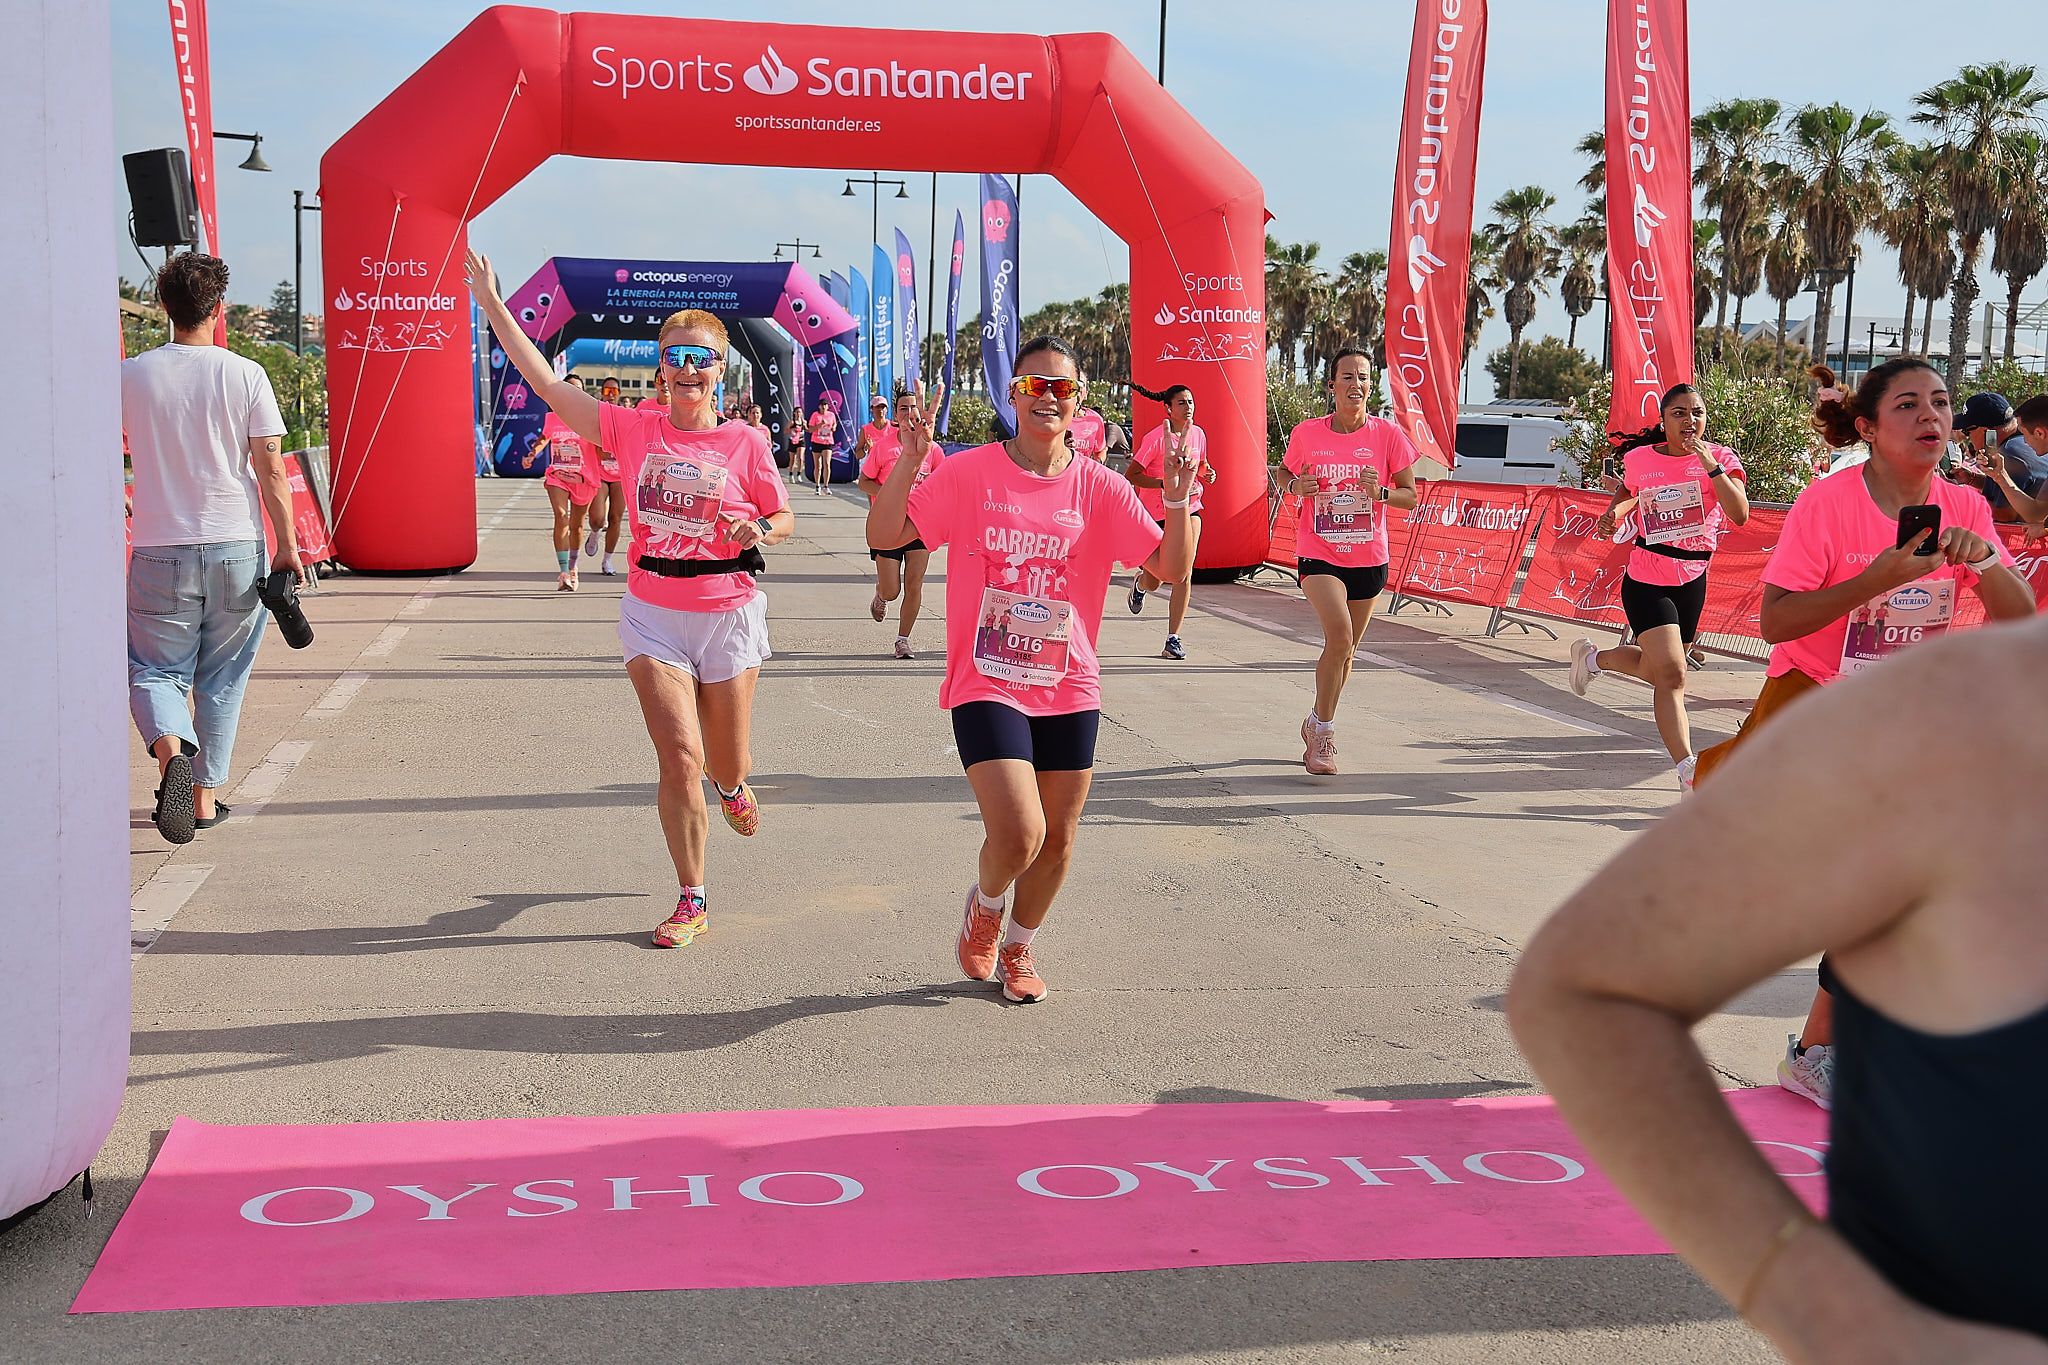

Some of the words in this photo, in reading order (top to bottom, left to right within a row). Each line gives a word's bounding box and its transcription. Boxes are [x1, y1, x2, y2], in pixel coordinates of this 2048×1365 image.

[592, 46, 734, 99] Sports
[807, 57, 1033, 101] Santander
[735, 115, 881, 132] sportssantander.es
[361, 256, 428, 281] Sports
[633, 270, 687, 285] octopus
[688, 272, 733, 287] energy
[1184, 272, 1243, 295] Sports
[356, 292, 457, 311] Santander
[607, 288, 620, 297] LA
[622, 287, 666, 299] ENERGÍA
[668, 290, 695, 299] PARA
[697, 291, 738, 300] CORRER
[631, 300, 688, 309] VELOCIDAD
[720, 302, 740, 310] LUZ
[1179, 305, 1262, 323] Santander
[603, 339, 655, 362] Marlene
[663, 490, 694, 507] 016
[984, 500, 1022, 515] OYSHO
[1457, 500, 1530, 531] Santander
[1660, 509, 1684, 521] 016
[1333, 514, 1354, 523] 016
[1553, 505, 1605, 541] Spor
[985, 526, 1071, 562] CARRERA
[1892, 597, 1929, 606] ASTURIANA
[1013, 606, 1049, 620] ASTURIANA
[1884, 626, 1924, 643] 016
[1007, 634, 1043, 653] 016
[1854, 651, 1880, 660] CARRERA
[982, 663, 1011, 675] OYSHO
[1016, 1149, 1586, 1201] OYSHO
[240, 1171, 865, 1226] OYSHO
